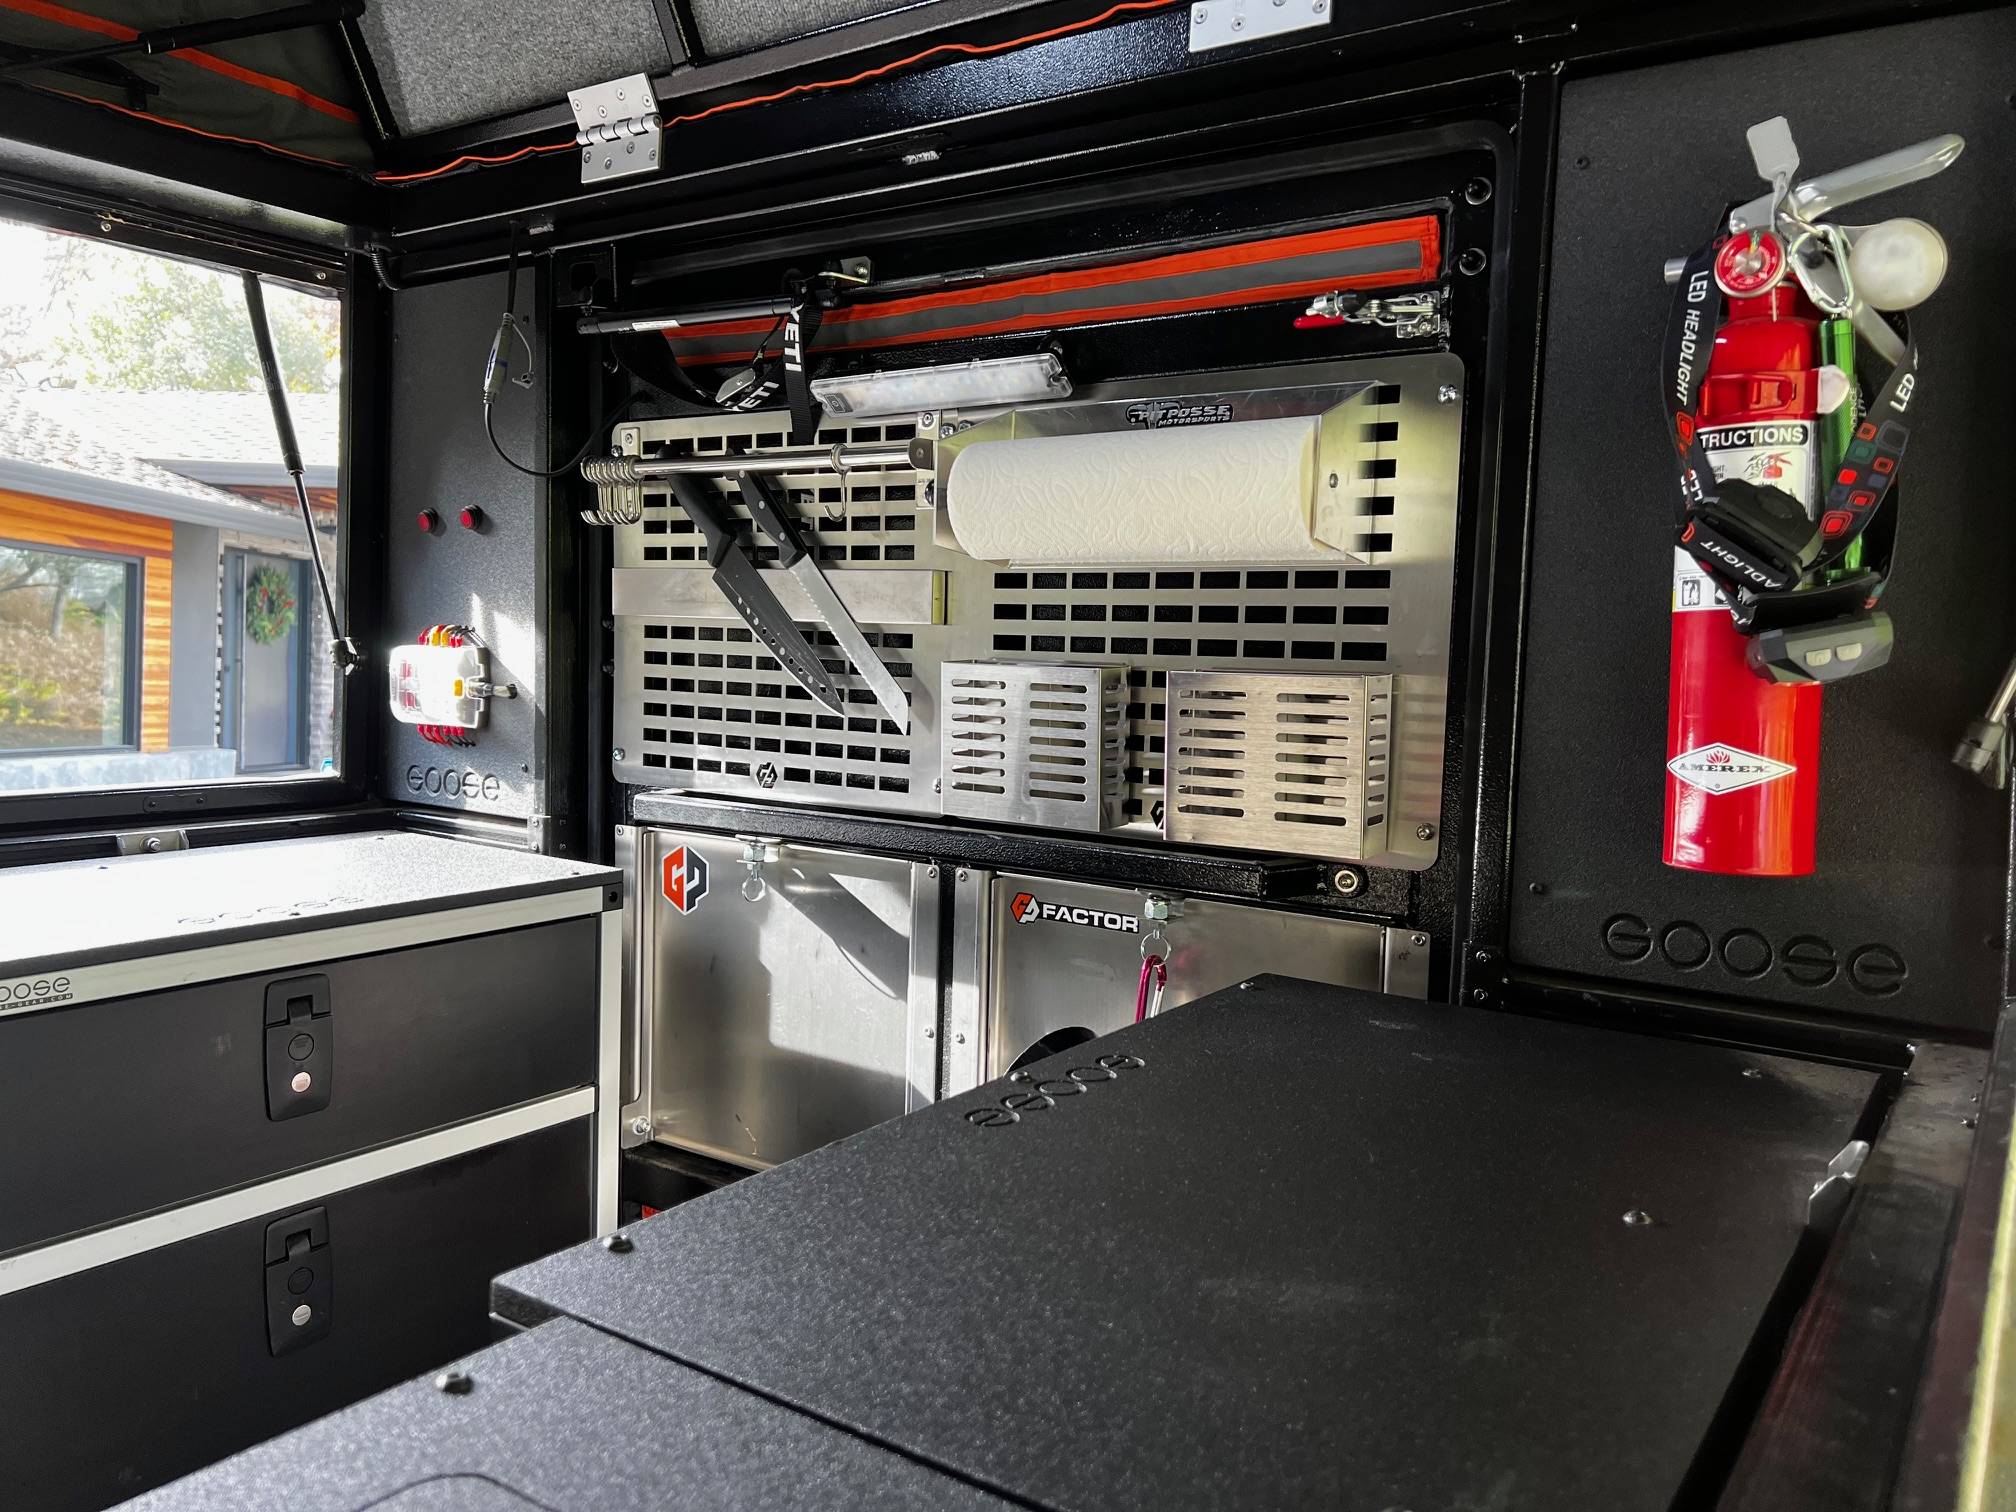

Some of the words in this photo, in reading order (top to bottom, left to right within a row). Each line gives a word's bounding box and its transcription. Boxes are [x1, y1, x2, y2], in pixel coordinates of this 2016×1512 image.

[1687, 270, 1710, 303] LED
[1676, 309, 1701, 406] HEADLIGHT
[1889, 373, 1915, 413] LED
[1158, 415, 1231, 427] MOTORSPORTS
[1678, 762, 1771, 773] AMEREX
[1042, 903, 1139, 933] FACTOR
